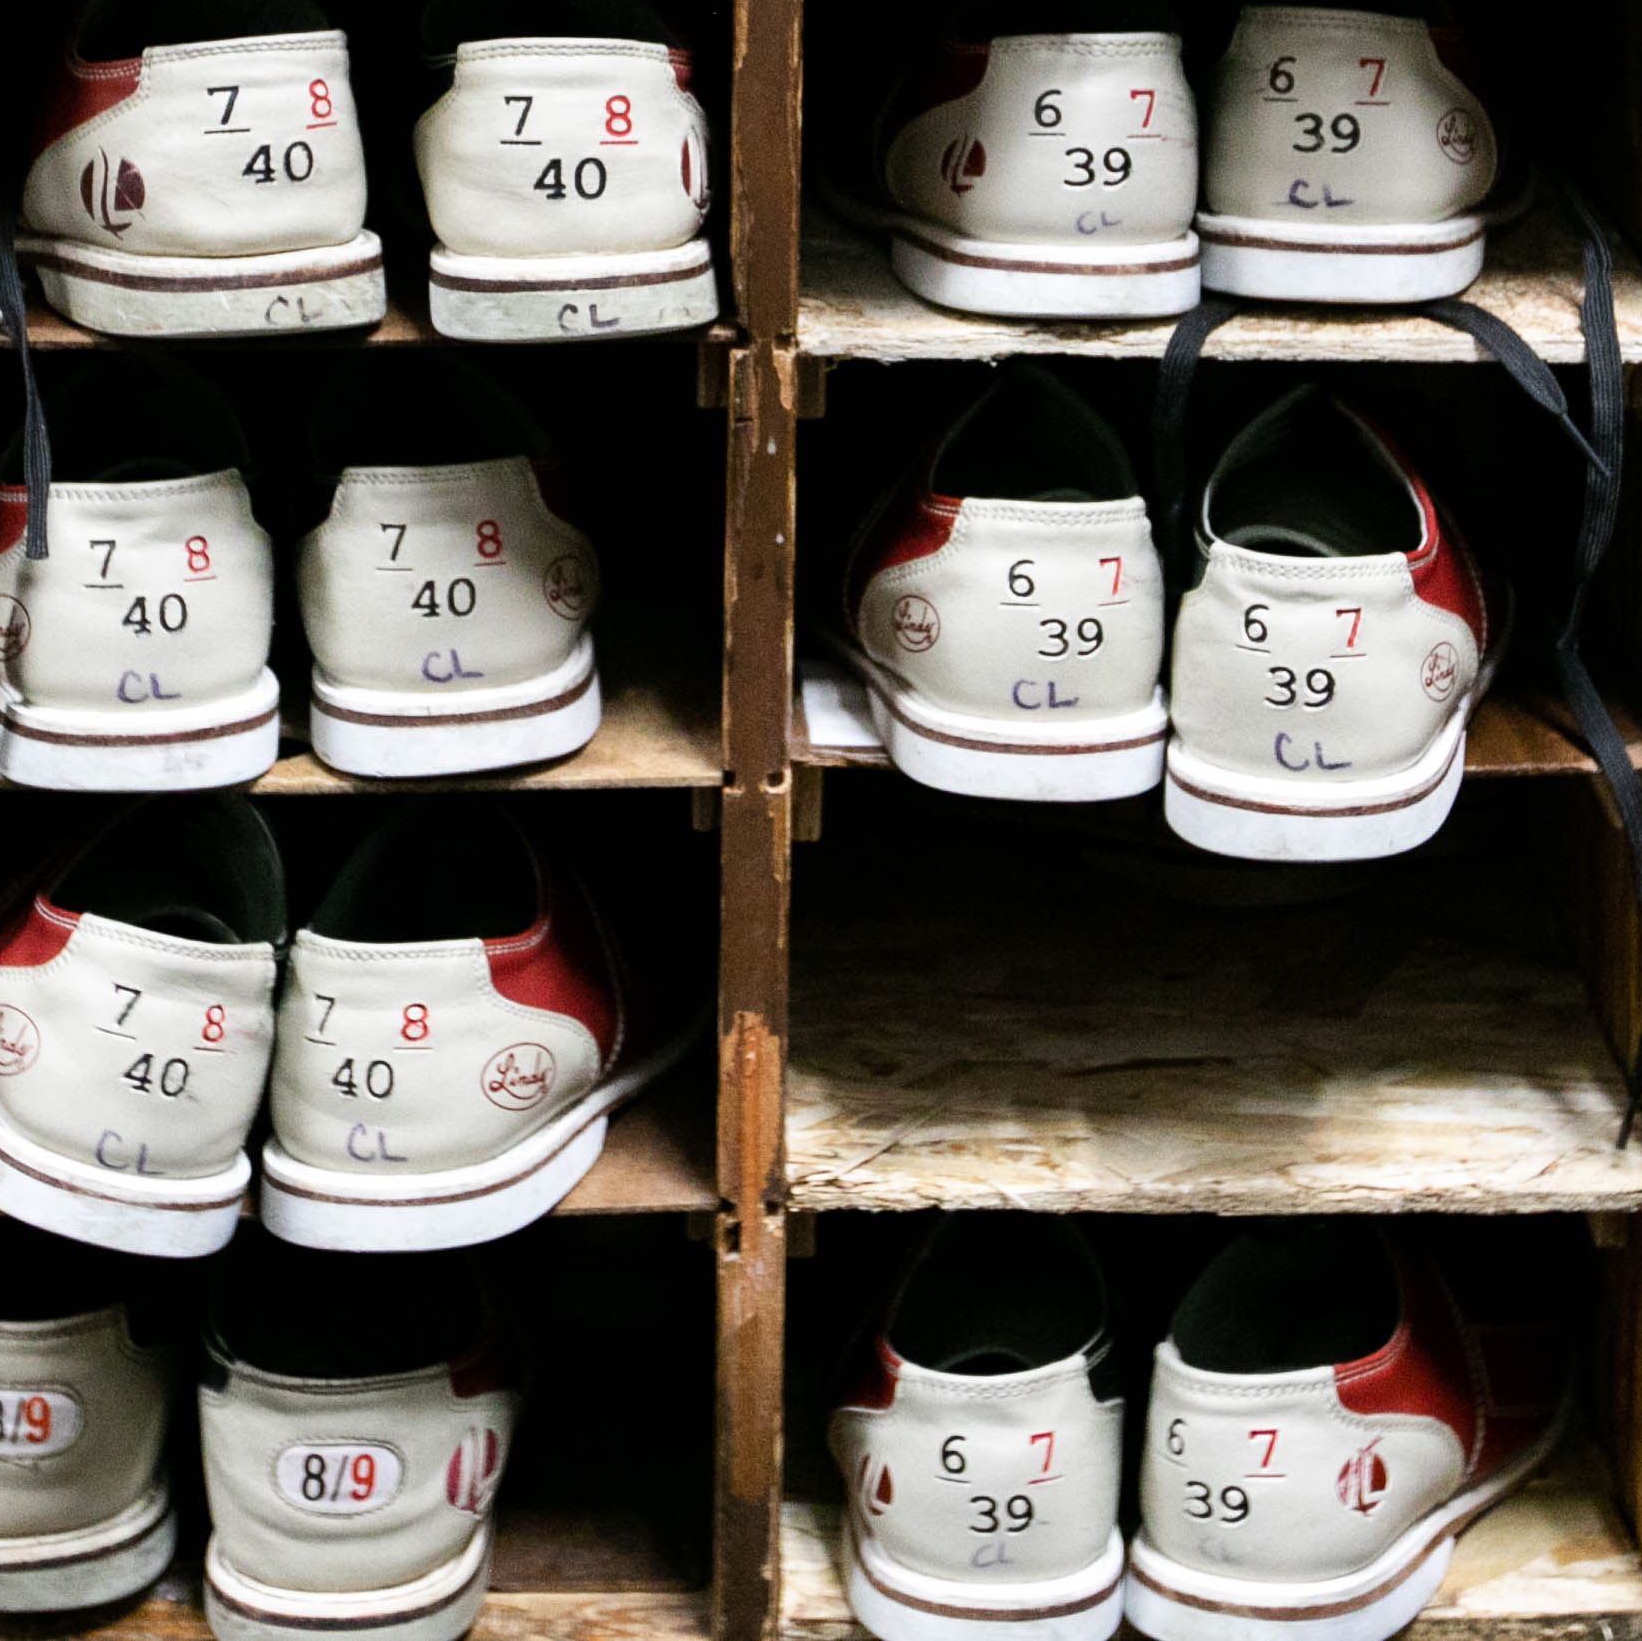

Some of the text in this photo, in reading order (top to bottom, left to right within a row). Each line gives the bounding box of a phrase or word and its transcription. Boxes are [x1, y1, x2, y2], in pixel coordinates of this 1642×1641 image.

[1269, 58, 1386, 96] 6 7
[208, 79, 333, 125] 7 8
[504, 95, 632, 138] 7 8
[1034, 91, 1155, 127] 6 7
[1294, 113, 1359, 154] 39
[242, 142, 314, 183] 40
[534, 157, 607, 199] 40
[1064, 147, 1131, 187] 39
[89, 536, 210, 579] 7 8
[380, 520, 502, 563] 7 8
[1009, 557, 1122, 596] 6 7
[122, 594, 188, 636] 40
[411, 579, 476, 617] 40
[1039, 618, 1104, 656] 39
[1243, 605, 1361, 648] 6 7
[1266, 667, 1335, 708] 39
[113, 984, 225, 1043] 7 8
[314, 995, 428, 1043] 7 8
[122, 1055, 190, 1097] 40
[333, 1059, 395, 1099] 40
[941, 1432, 1055, 1474] 6 7
[1168, 1419, 1278, 1467] 6 7
[301, 1453, 374, 1501] 8/9
[970, 1495, 1033, 1533] 39
[1183, 1482, 1249, 1522] 39
